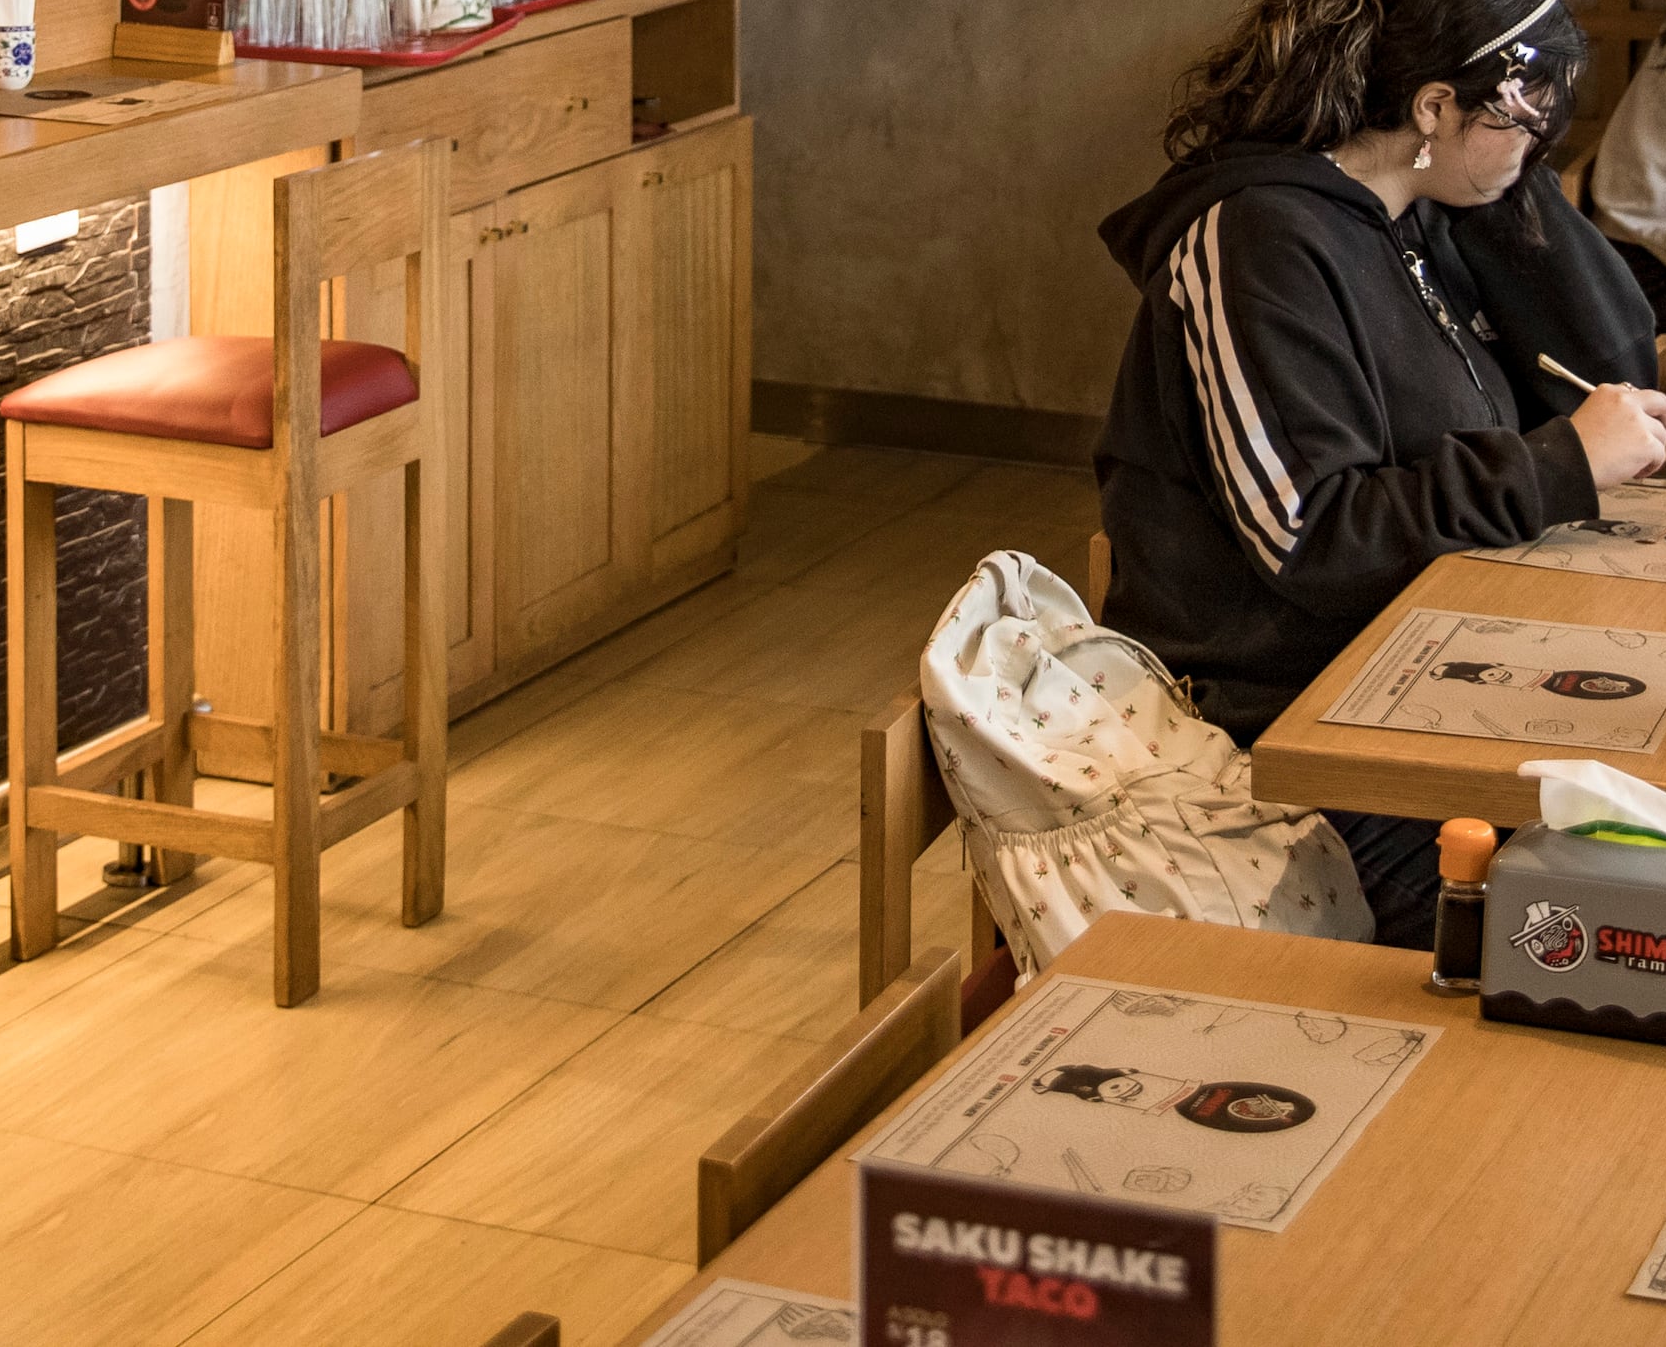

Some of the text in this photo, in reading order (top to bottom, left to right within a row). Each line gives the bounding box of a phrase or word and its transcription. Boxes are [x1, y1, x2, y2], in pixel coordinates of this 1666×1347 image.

[891, 1211, 1190, 1294] SAKU SHAKE
[978, 1265, 1100, 1321] TACO
